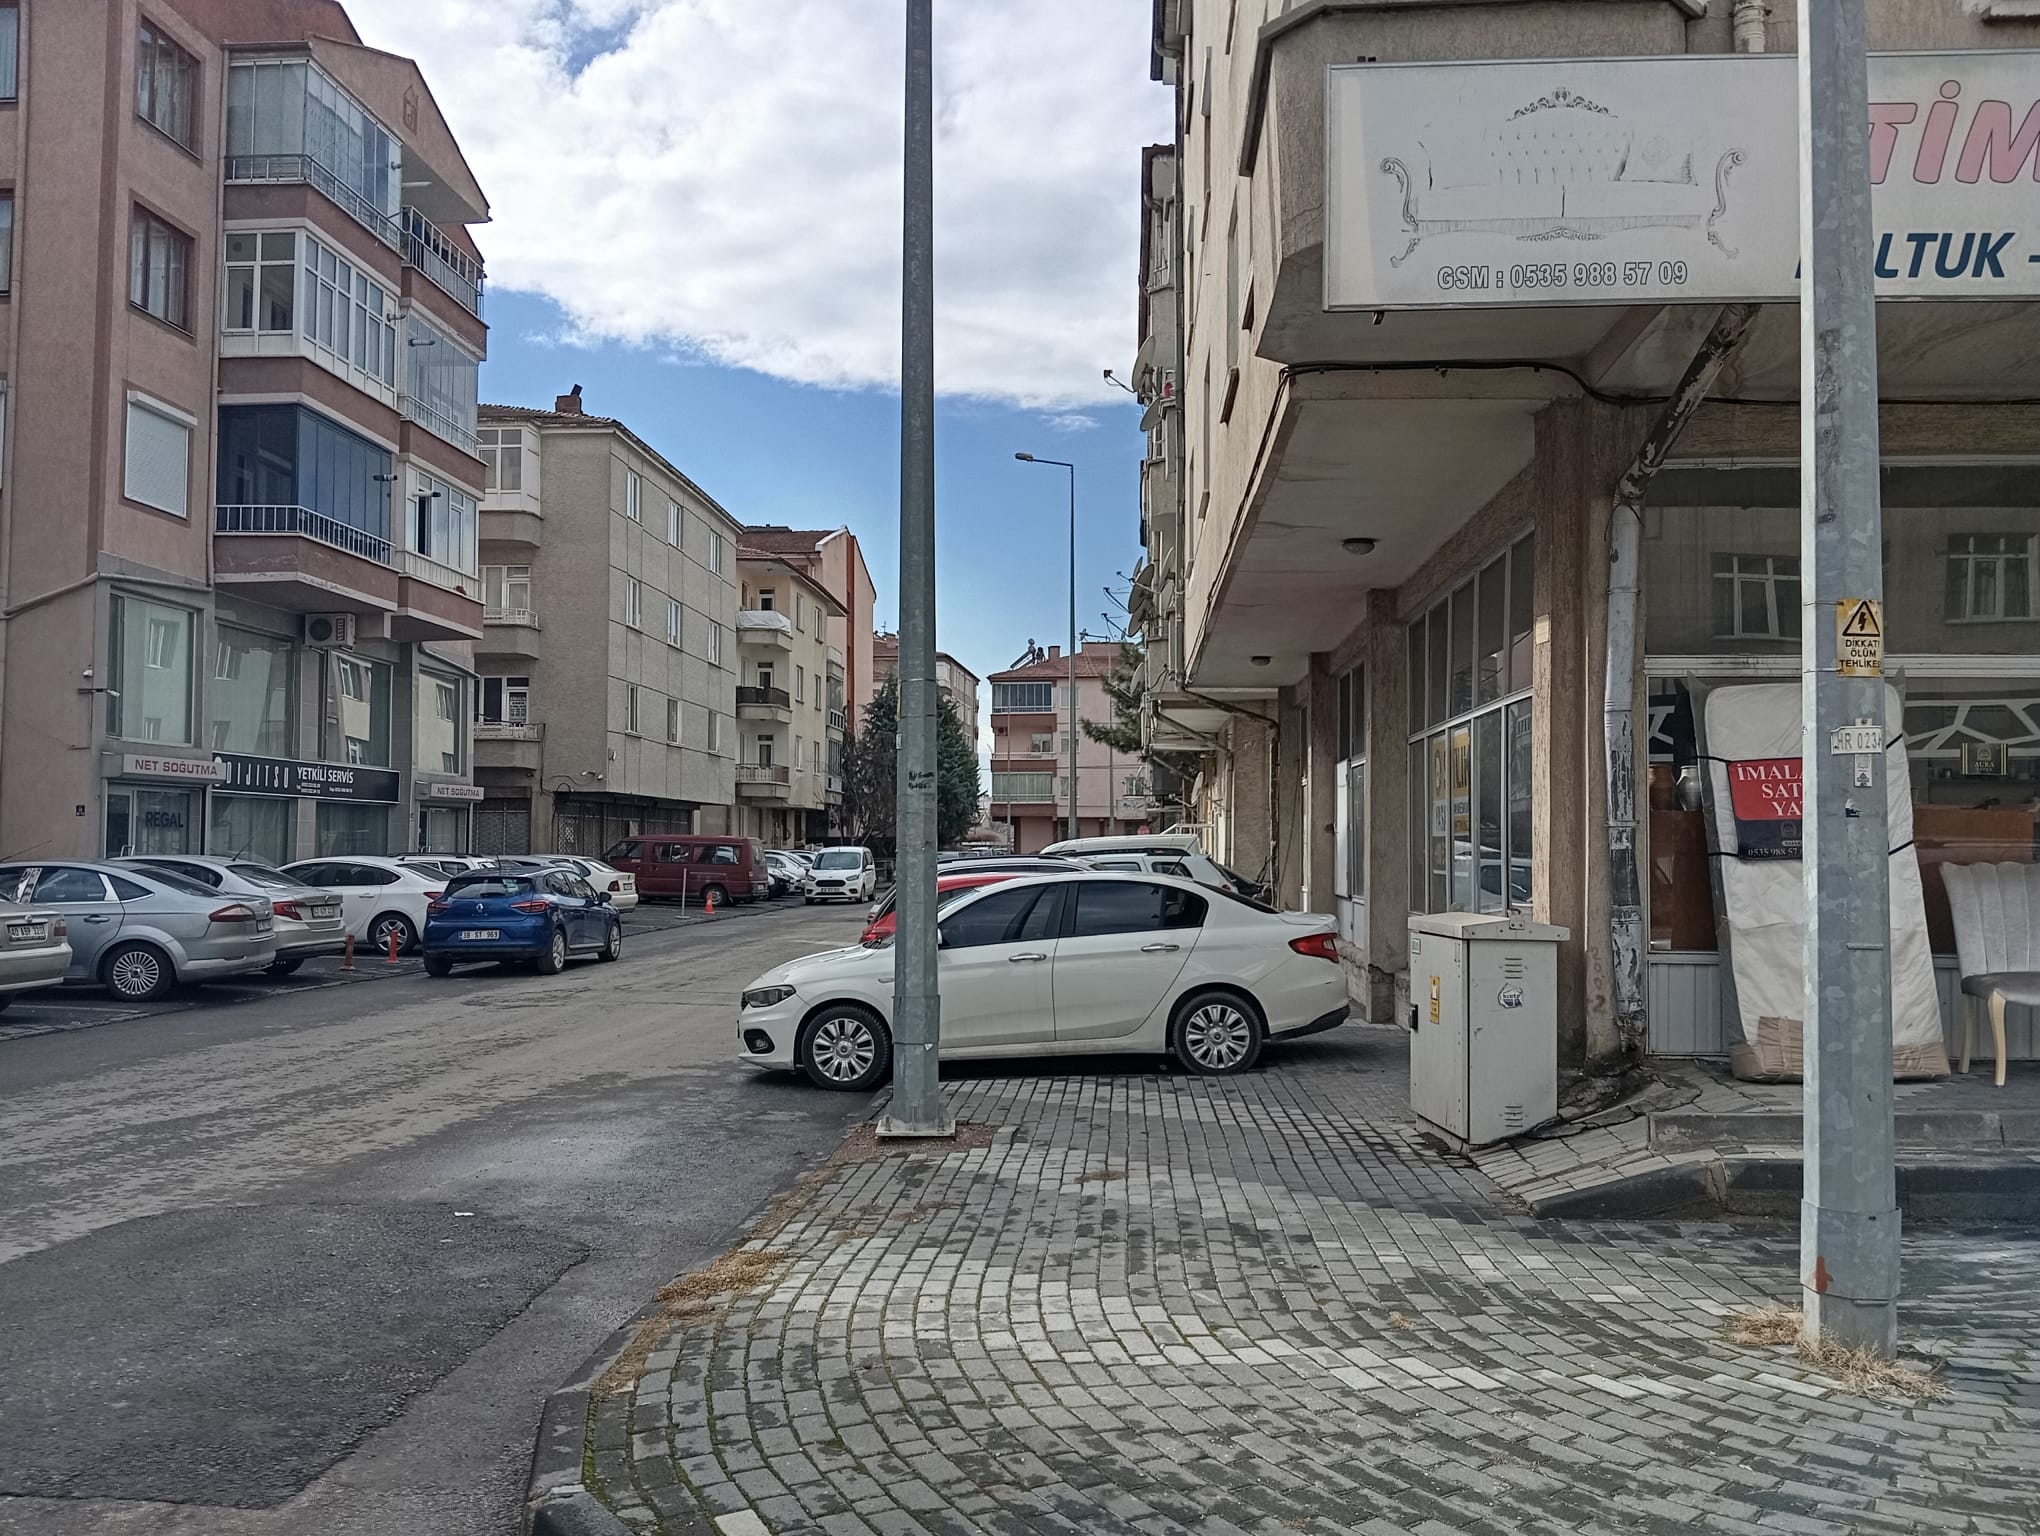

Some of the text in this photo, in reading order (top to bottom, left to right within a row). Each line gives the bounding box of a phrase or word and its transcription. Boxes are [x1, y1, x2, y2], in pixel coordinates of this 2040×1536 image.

[1437, 265, 1490, 290] GSM
[1510, 263, 1567, 288] 0535
[1573, 262, 1617, 287] 988
[1623, 261, 1652, 286] 57
[1659, 260, 1688, 285] 09
[1850, 647, 1877, 658] ÖLÜM
[135, 759, 218, 776] NET SOĞUTMA
[297, 765, 327, 781] YETKİLİ
[327, 768, 354, 784] SERVİS
[437, 786, 449, 795] NET
[145, 811, 184, 829] REGAL
[1770, 847, 1786, 856] 988
[1788, 847, 1798, 855] 57
